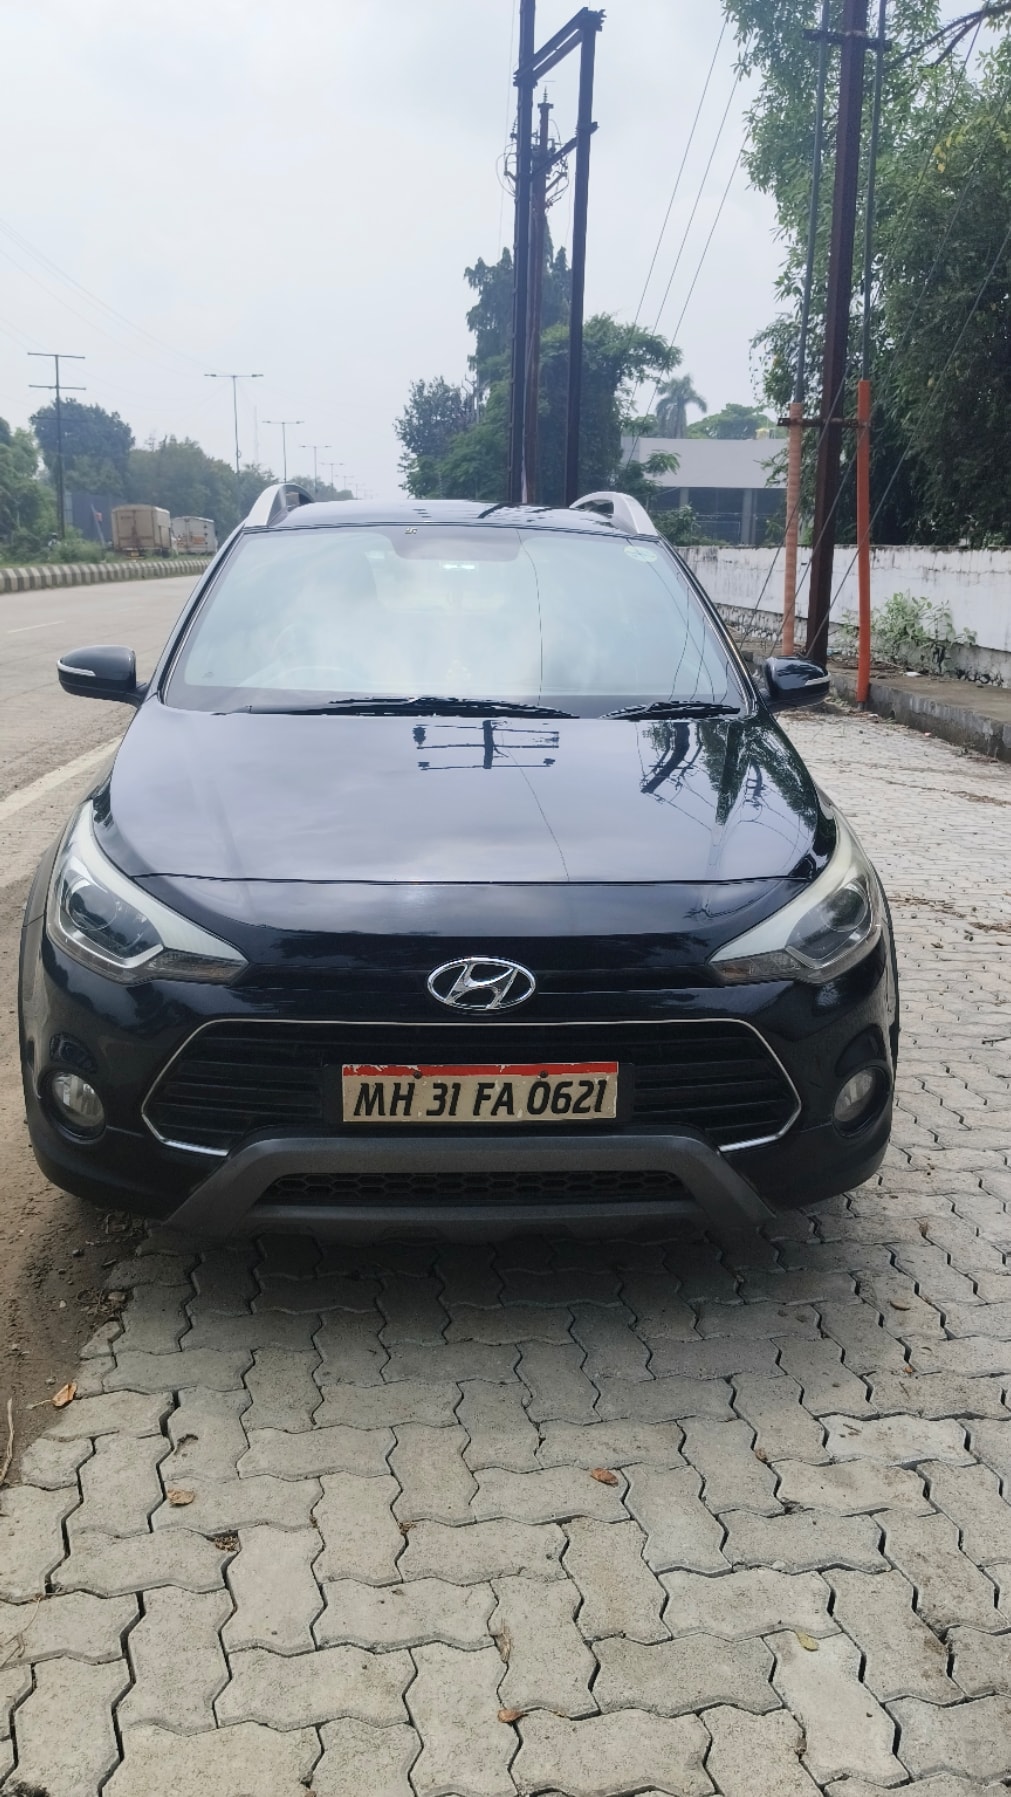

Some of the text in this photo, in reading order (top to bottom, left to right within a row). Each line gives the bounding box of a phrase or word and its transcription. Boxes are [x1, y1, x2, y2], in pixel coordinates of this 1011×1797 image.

[353, 1080, 607, 1116] MH 31 FA 0621
